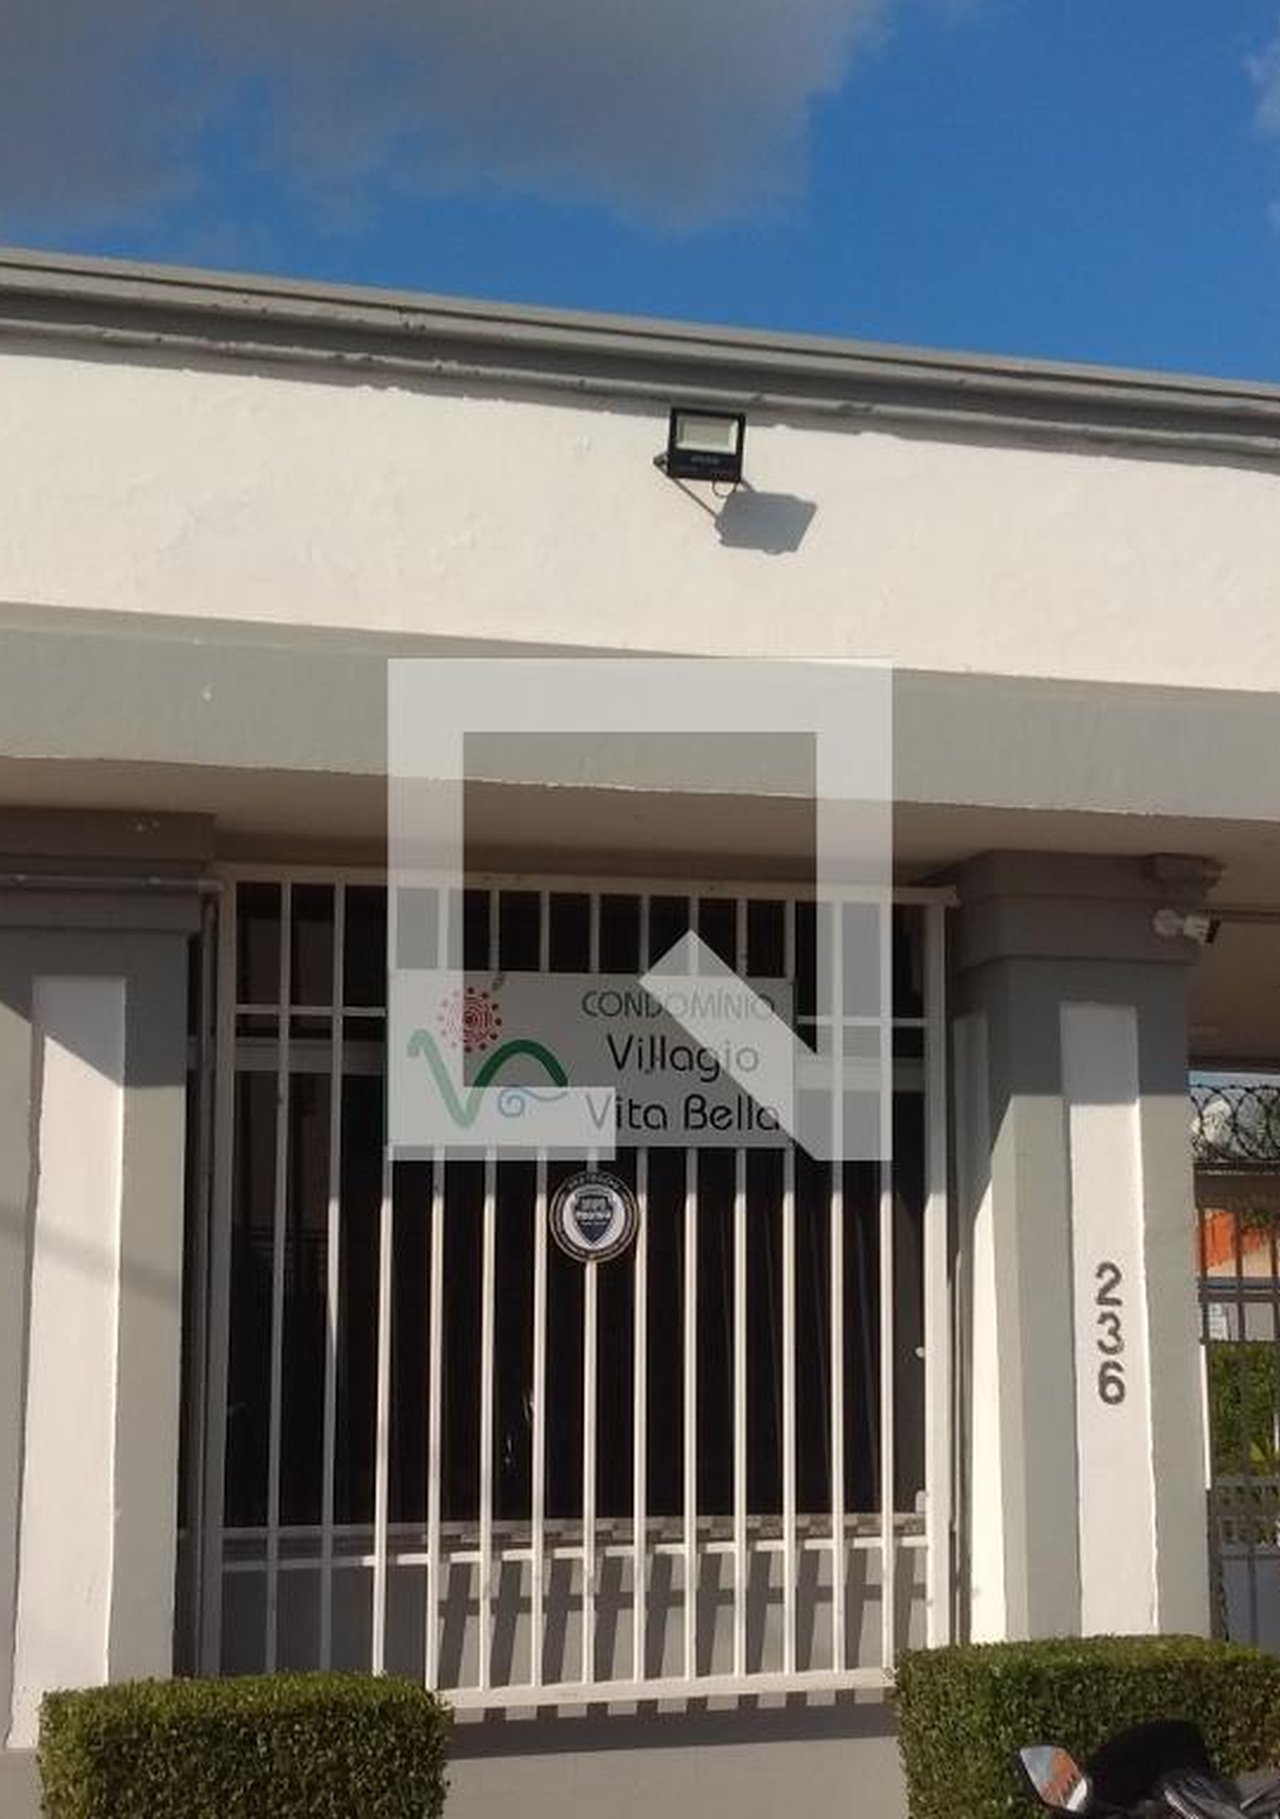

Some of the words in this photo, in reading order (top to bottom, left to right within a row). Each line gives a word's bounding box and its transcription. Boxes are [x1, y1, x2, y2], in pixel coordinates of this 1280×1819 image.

[606, 1032, 759, 1082] Villagio
[585, 1093, 669, 1130] Vita
[684, 1093, 781, 1130] Bella
[1095, 1261, 1126, 1405] 236
